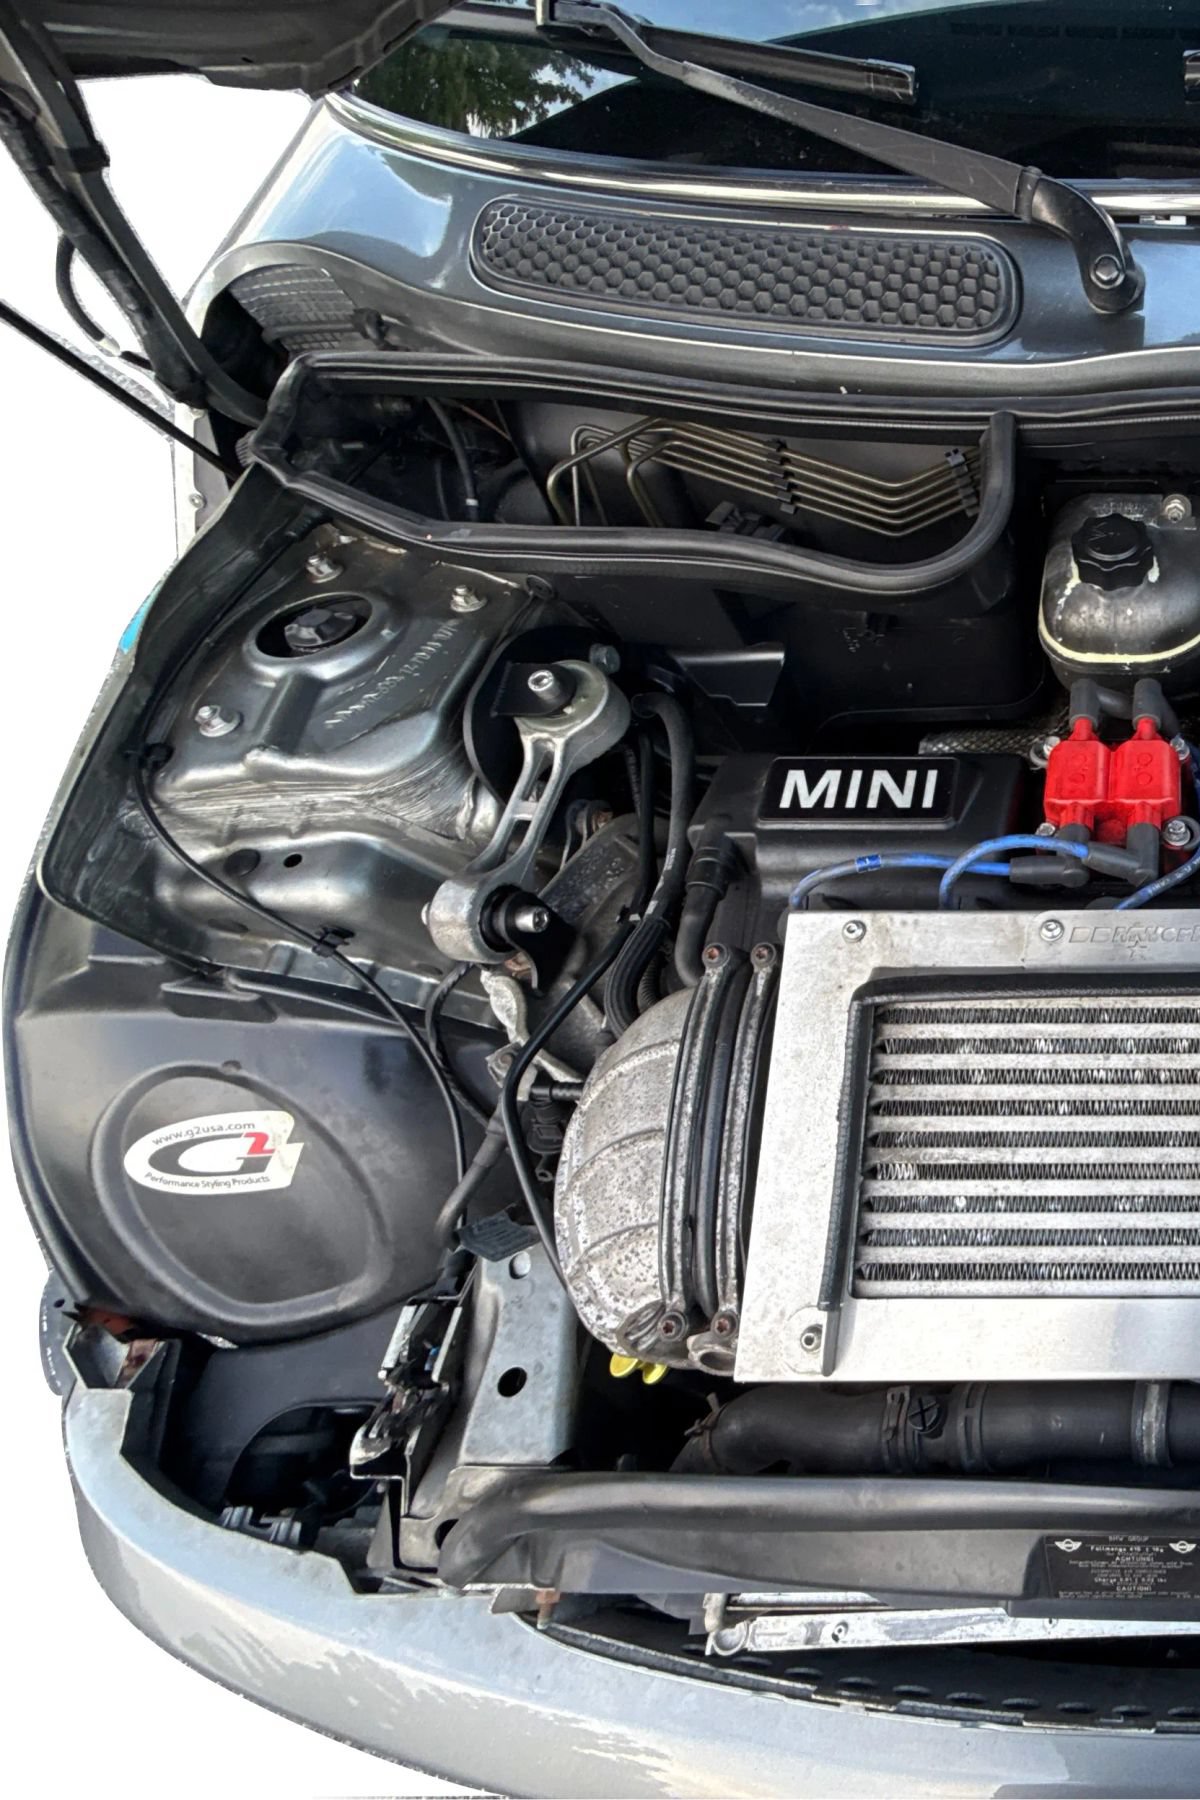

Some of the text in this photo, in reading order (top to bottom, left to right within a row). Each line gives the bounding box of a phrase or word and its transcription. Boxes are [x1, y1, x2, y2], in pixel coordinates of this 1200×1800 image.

[779, 770, 938, 808] MINI
[152, 1122, 256, 1146] www.g2usa.com
[145, 1172, 271, 1190] Performance Styling Products
